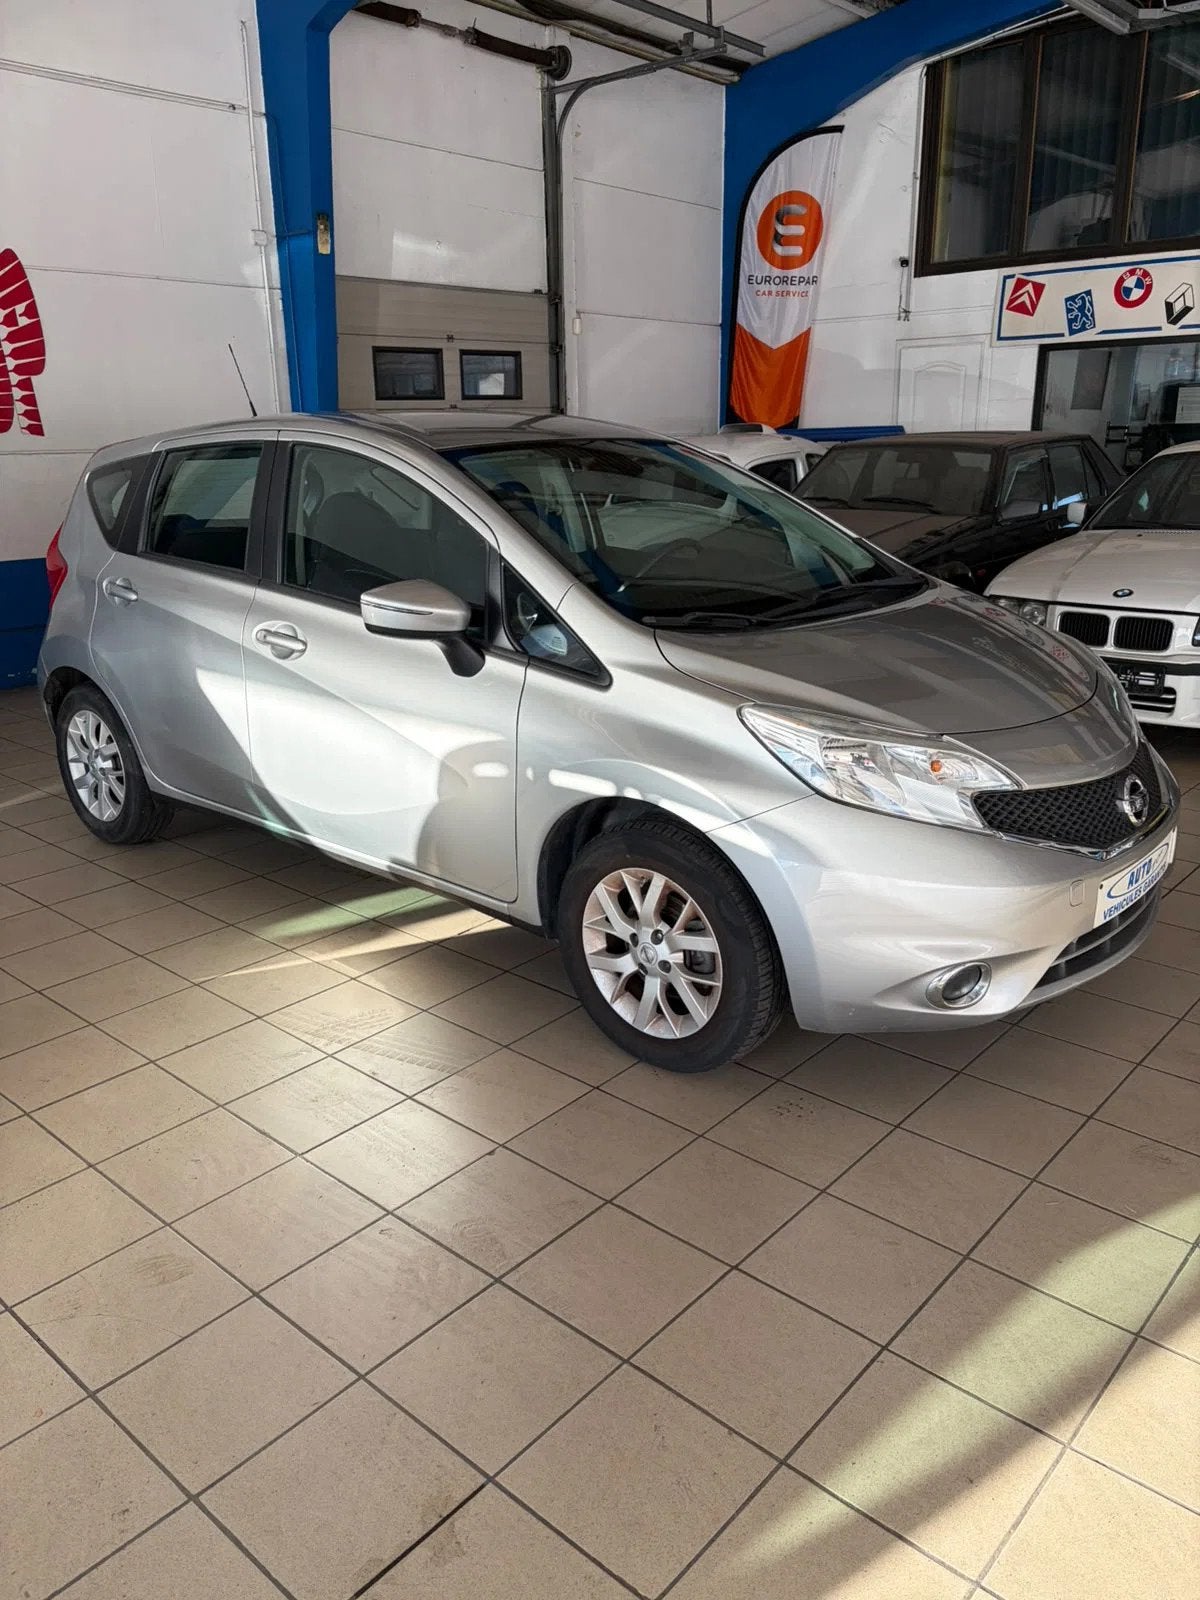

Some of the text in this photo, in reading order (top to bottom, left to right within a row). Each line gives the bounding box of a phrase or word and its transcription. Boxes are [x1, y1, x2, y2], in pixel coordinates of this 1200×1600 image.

[747, 274, 818, 286] EUROREPAR
[1122, 268, 1152, 285] BMW
[775, 290, 809, 298] SERVICE
[1127, 857, 1152, 889] AUTO
